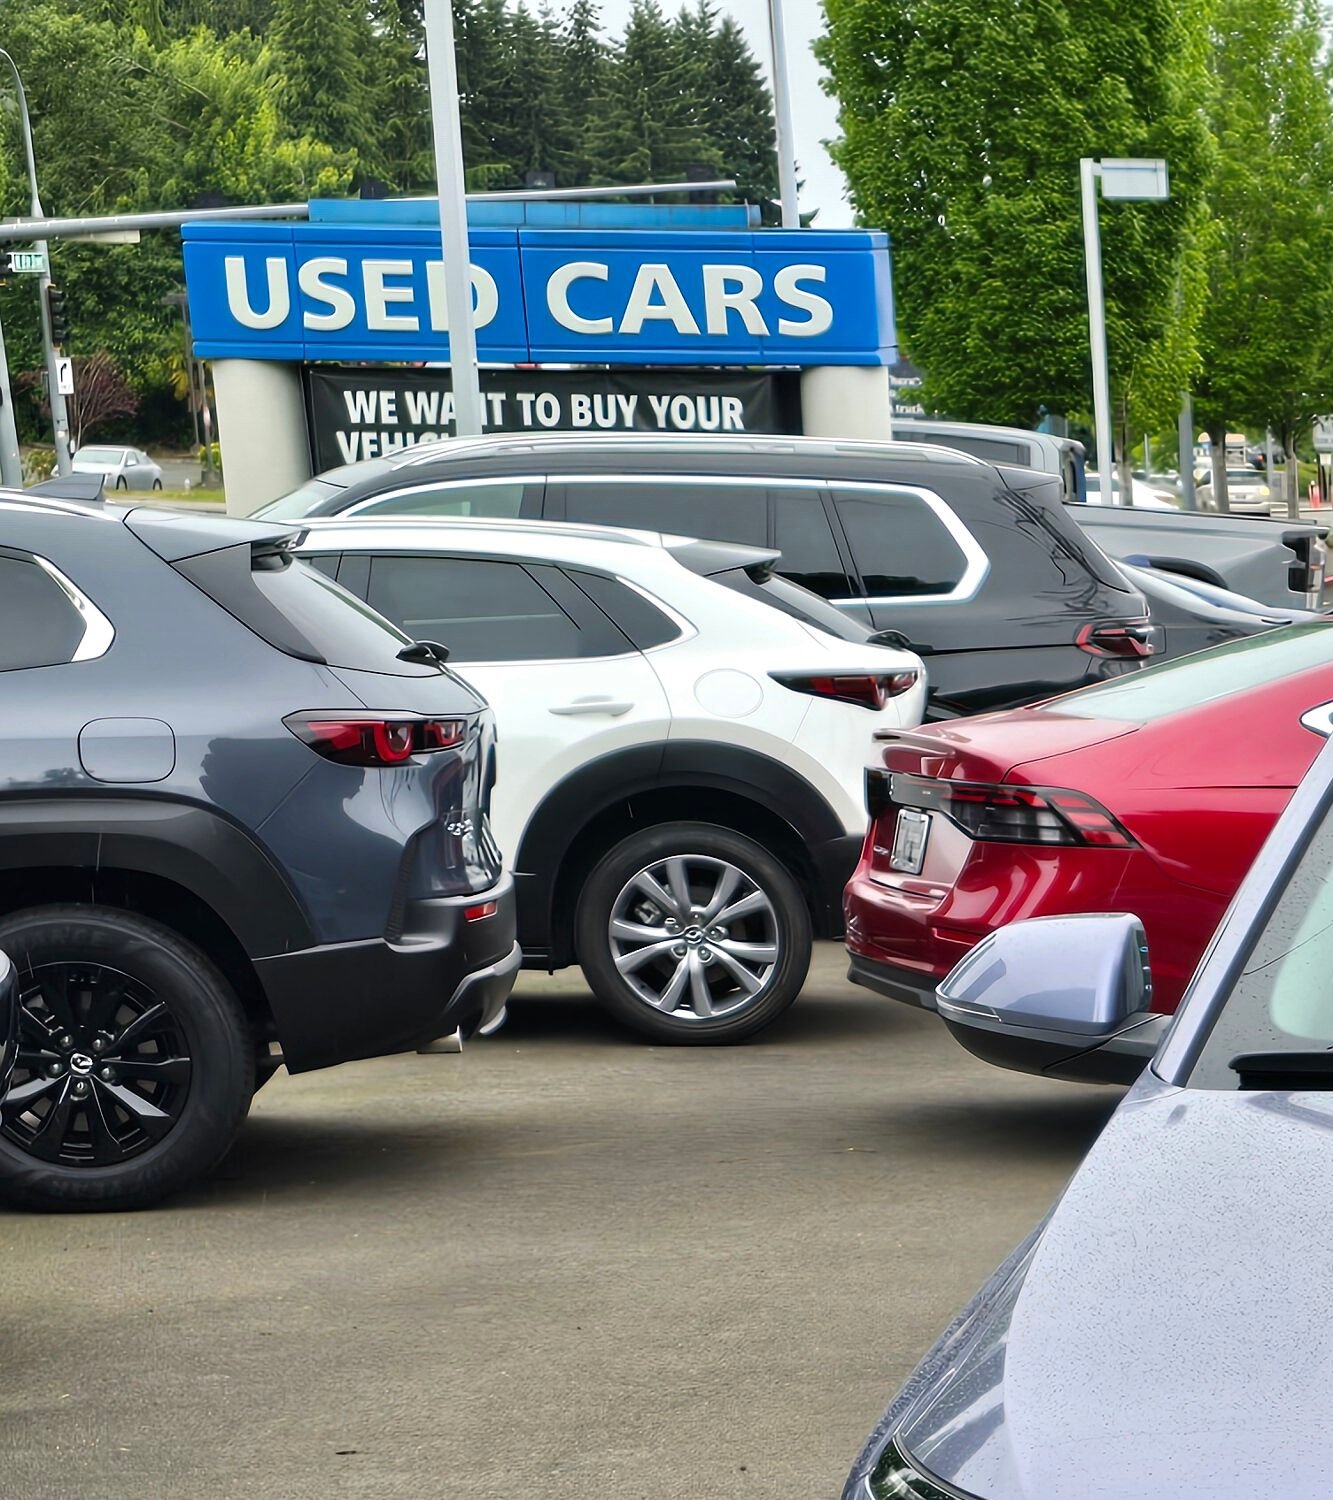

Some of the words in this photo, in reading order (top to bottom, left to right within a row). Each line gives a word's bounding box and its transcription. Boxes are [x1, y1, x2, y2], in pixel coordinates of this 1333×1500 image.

[224, 255, 499, 331] USED
[546, 261, 834, 337] CARS
[343, 390, 399, 424] WE
[516, 392, 561, 427] TO
[570, 393, 638, 429] BUY
[648, 394, 745, 431] YOUR
